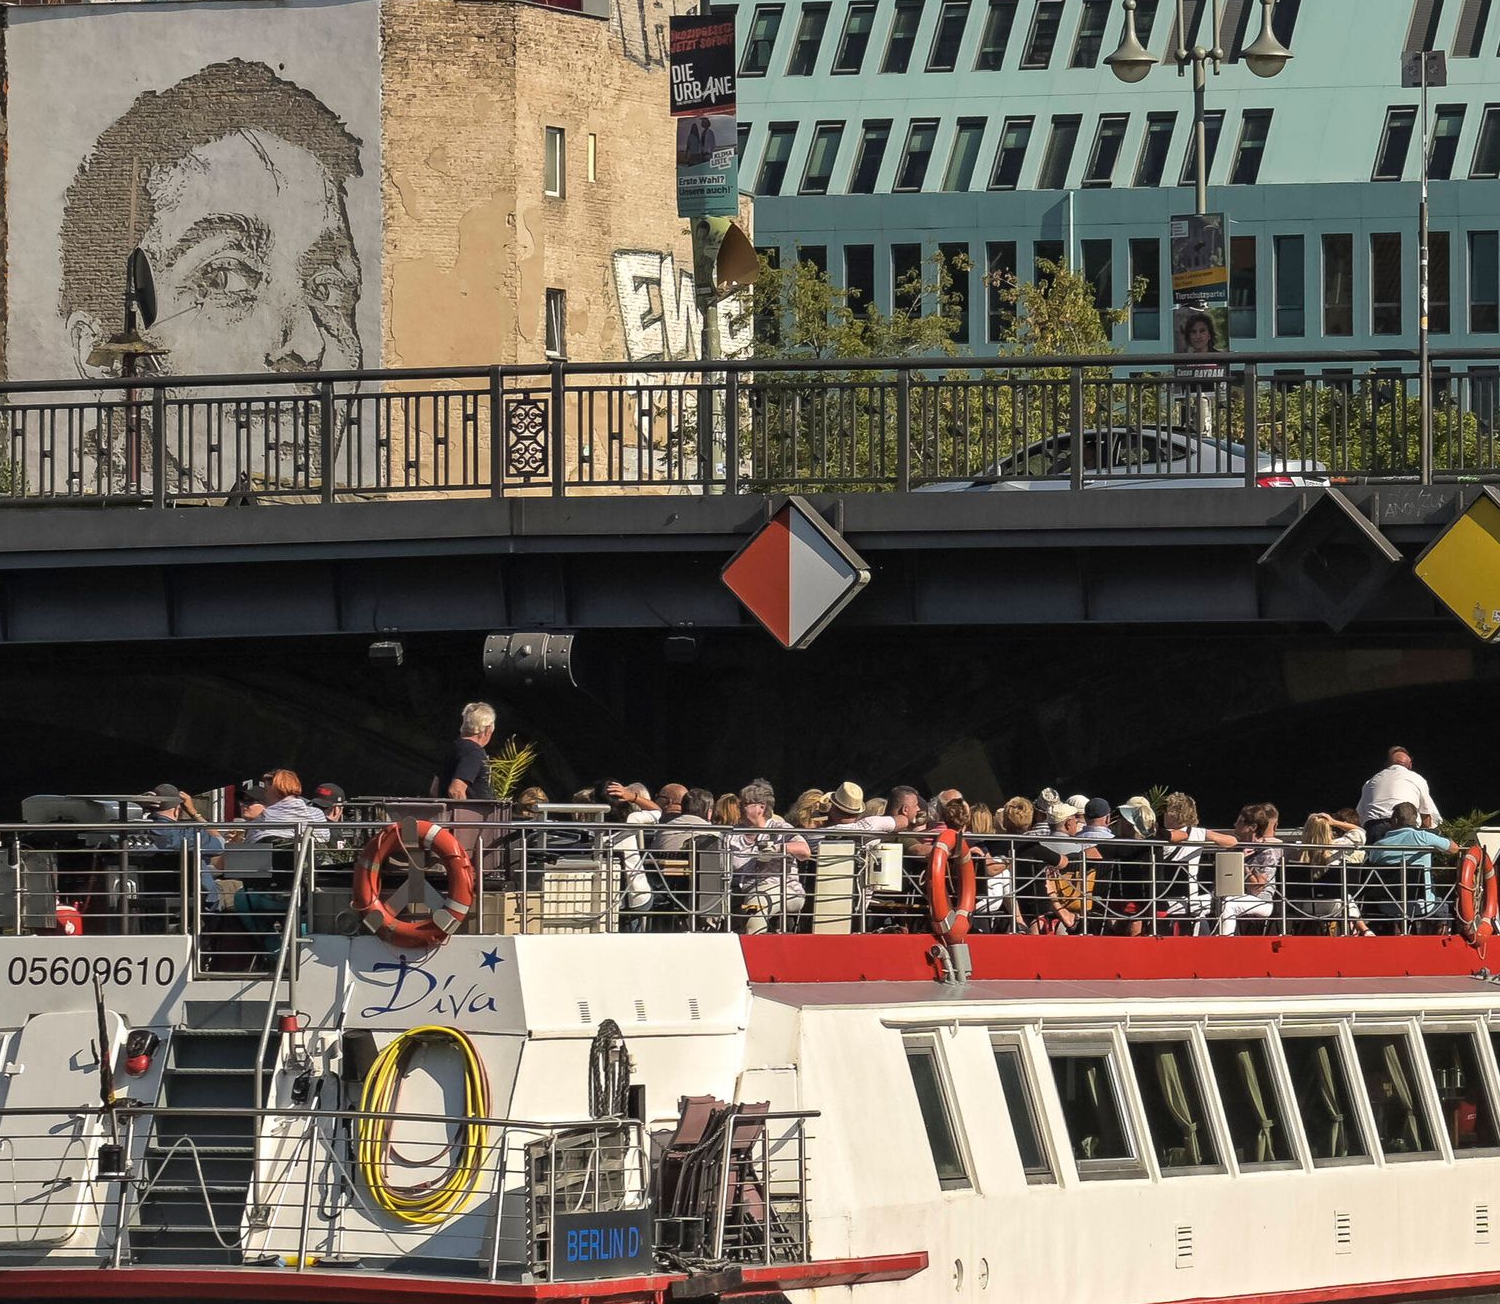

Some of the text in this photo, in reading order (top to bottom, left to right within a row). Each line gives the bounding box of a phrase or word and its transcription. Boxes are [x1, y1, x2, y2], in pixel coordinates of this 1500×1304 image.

[671, 63, 695, 83] DIE
[679, 176, 725, 186] Erste Wahl?
[7, 955, 175, 987] 05609610
[360, 959, 499, 1020] Diva
[567, 1226, 640, 1262] BERLIN D
